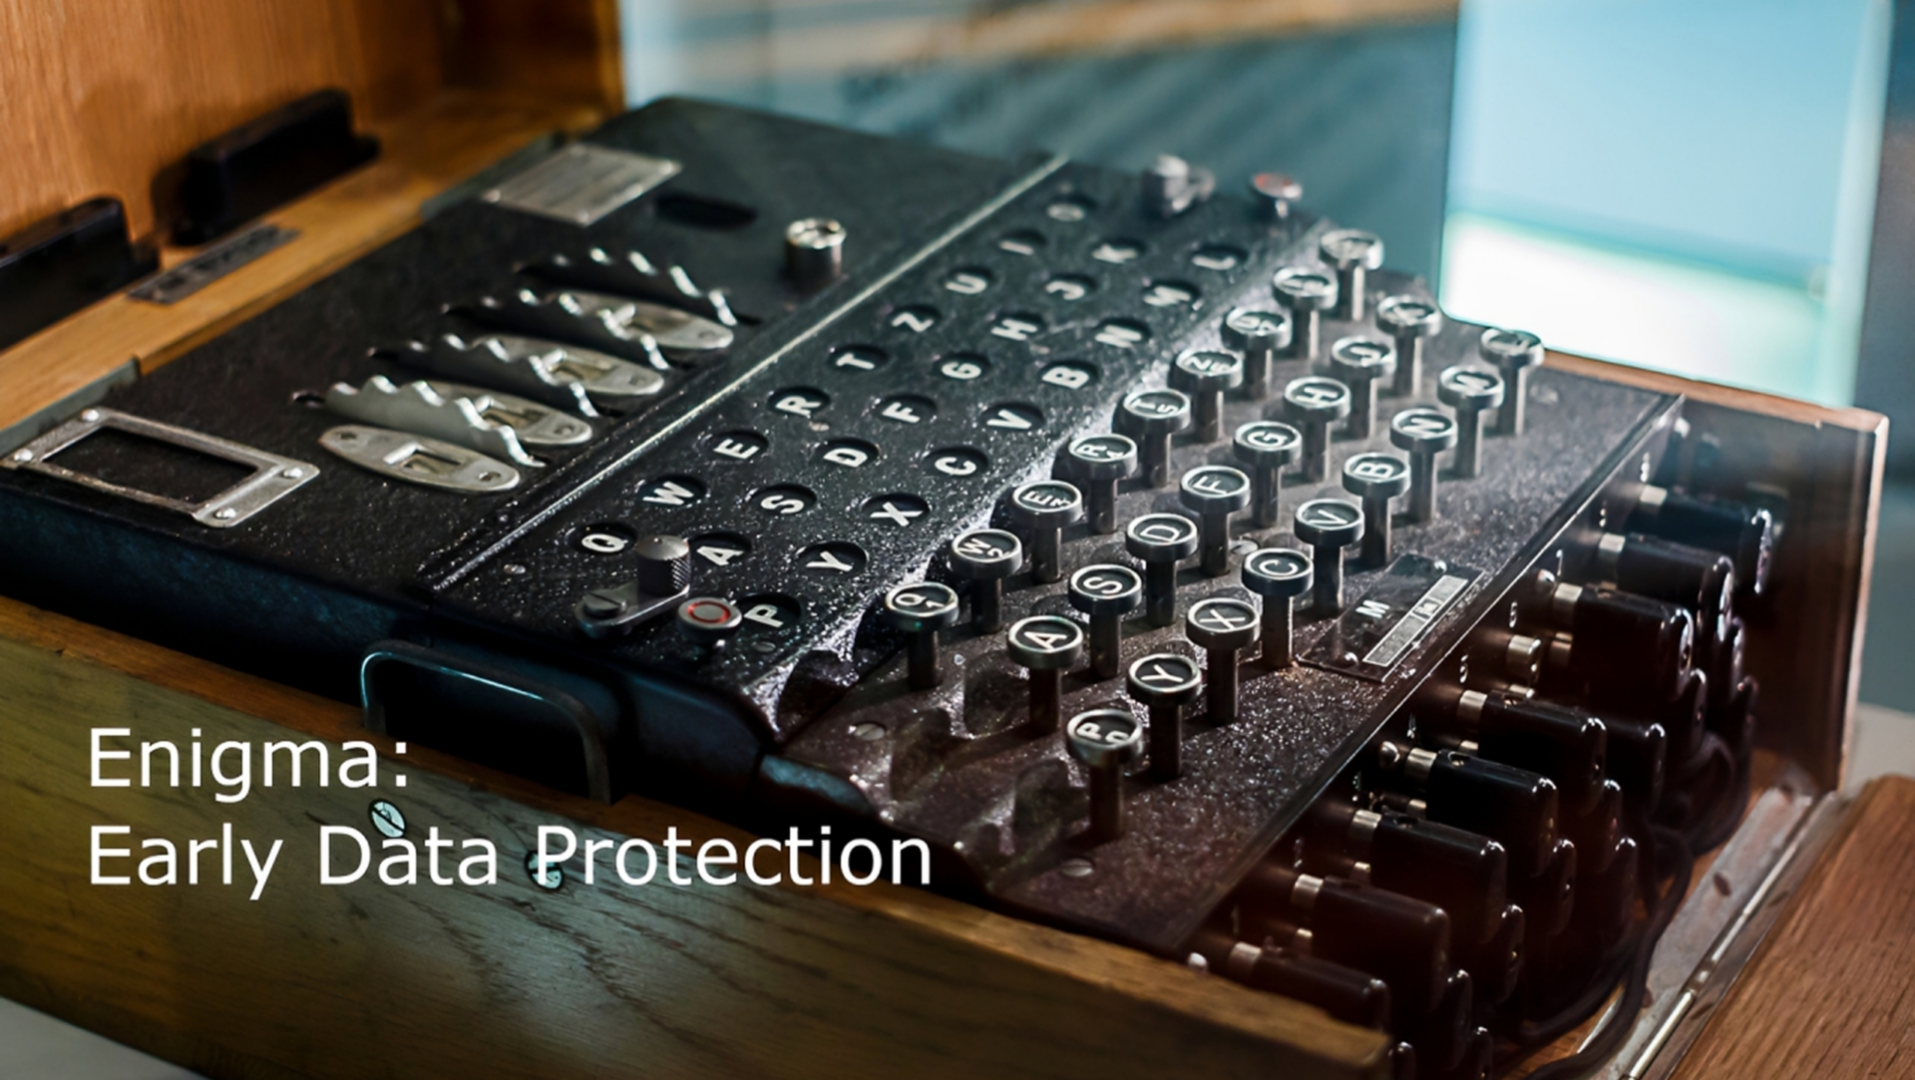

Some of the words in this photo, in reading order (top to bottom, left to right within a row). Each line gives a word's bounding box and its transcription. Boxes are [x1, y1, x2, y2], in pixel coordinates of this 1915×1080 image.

[945, 274, 987, 294] U
[1046, 280, 1085, 300] J
[990, 318, 1038, 341] H
[1095, 325, 1142, 348] N
[836, 354, 875, 370] T
[941, 361, 982, 380] G
[1042, 366, 1090, 389] B
[1296, 387, 1338, 403] H
[775, 396, 822, 416] R
[881, 402, 921, 423] F
[986, 409, 1032, 430] V
[713, 438, 760, 460] E
[1248, 431, 1287, 447] G
[823, 447, 868, 467] D
[934, 456, 977, 476] C
[1353, 462, 1394, 478] B
[643, 481, 695, 505] W
[1195, 476, 1228, 495] F
[760, 494, 804, 514] S
[870, 501, 923, 527] X
[1308, 510, 1347, 524] V
[581, 533, 628, 553] Q
[1140, 524, 1180, 542] D
[697, 545, 743, 566] A
[806, 551, 853, 572] Y
[1259, 560, 1298, 576] C
[1083, 576, 1123, 595] S
[744, 604, 784, 628] P
[1200, 609, 1246, 630] X
[1355, 600, 1390, 619] M
[1024, 631, 1067, 649] A
[1141, 664, 1184, 683] Y
